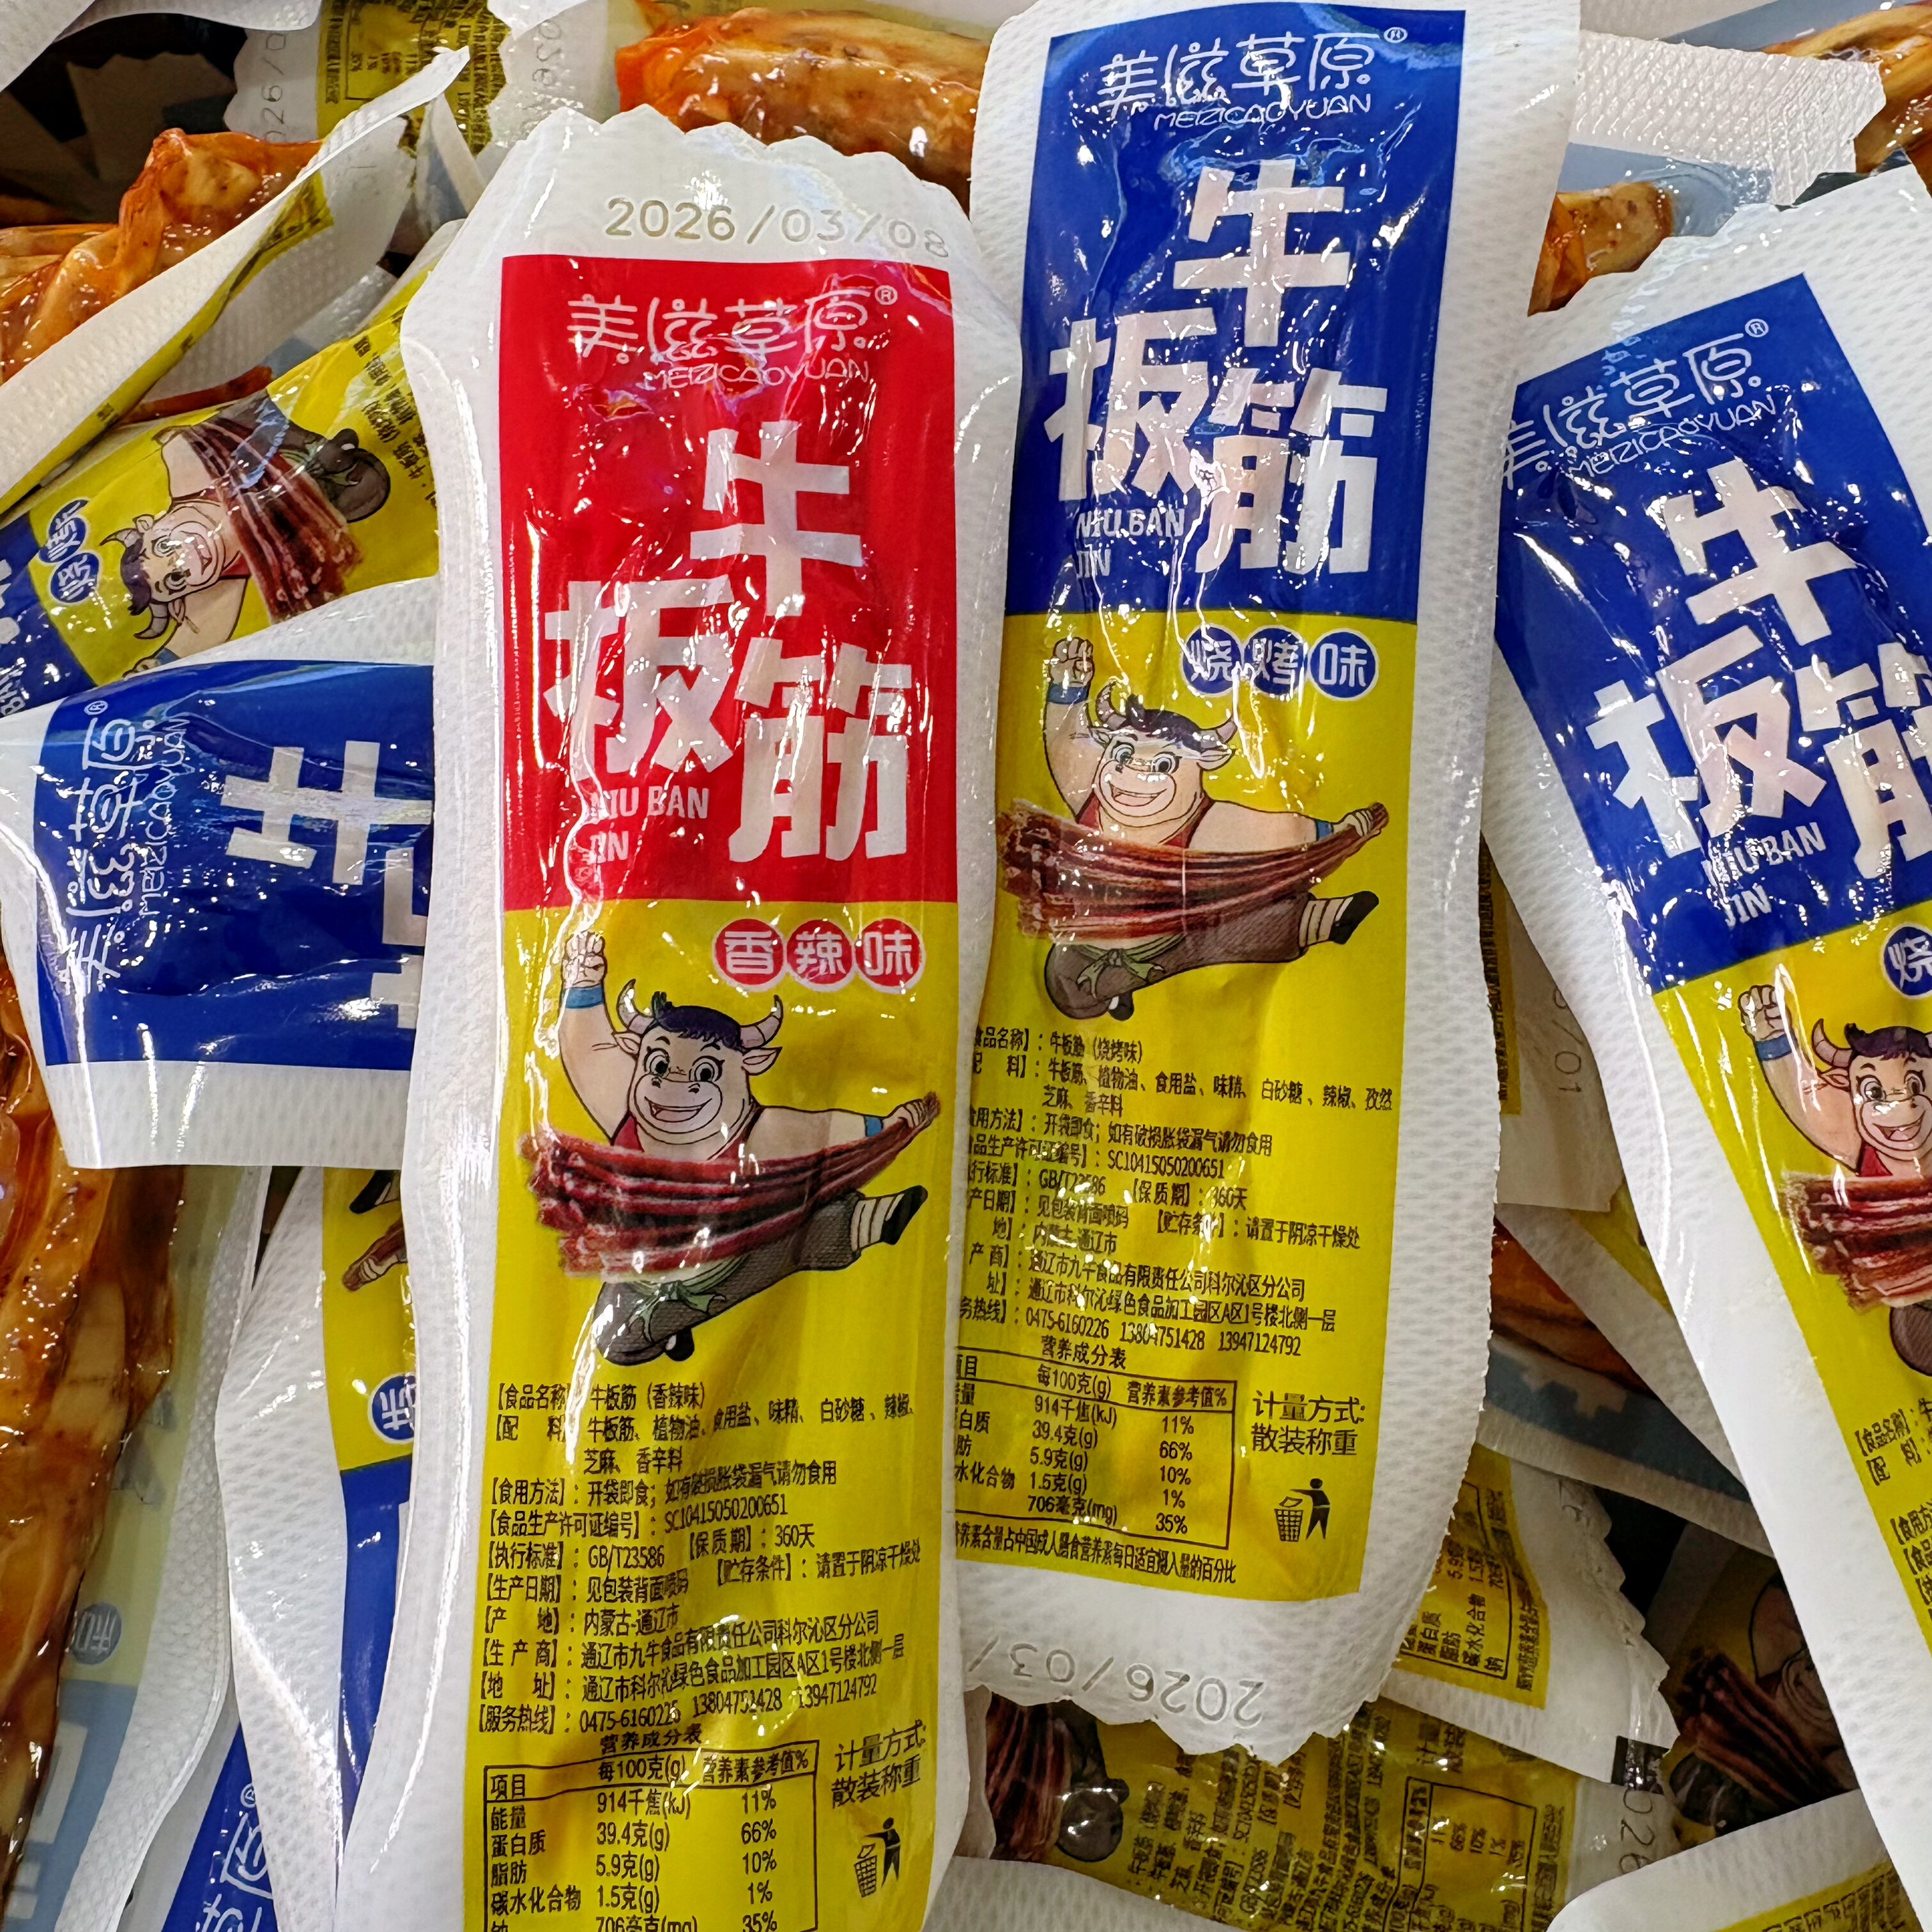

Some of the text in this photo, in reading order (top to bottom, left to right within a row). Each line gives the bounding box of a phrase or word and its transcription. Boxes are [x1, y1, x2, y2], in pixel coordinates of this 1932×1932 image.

[604, 197, 950, 258] 2026/03/08
[48, 502, 95, 602] 烧烤
[1188, 640, 1367, 688] 烧烤味
[648, 785, 709, 819] BAN
[1761, 821, 1828, 866] BAN
[724, 930, 914, 977] 香辣味
[1041, 1334, 1127, 1370] 营养成分表
[1218, 1330, 1301, 1356] 13947124792
[1032, 1419, 1099, 1450] 39.4克(g)
[1159, 1440, 1193, 1462] 66%
[1160, 1415, 1195, 1436] 11%
[1250, 1422, 1358, 1456] 散装称重
[1029, 1446, 1089, 1473] 5.9克(g)
[1159, 1465, 1192, 1486] 10%
[1030, 1471, 1088, 1497] 1.5克(g)
[1162, 1488, 1186, 1509] 1%
[1155, 1512, 1188, 1535] 35%
[599, 1723, 703, 1756] 营养成分表
[490, 1773, 526, 1800] 项目
[831, 1753, 921, 1809] 散装称重
[490, 1804, 527, 1831] 能量
[742, 1788, 777, 1814] 11%
[490, 1818, 777, 1859] 蛋白质 39.4克(g) 66%
[490, 1848, 778, 1887] 脂肪 5.9克(g) 10%
[490, 1879, 773, 1916] 碳水化合物 1.5克(g) 1%
[742, 1910, 778, 1932] 35%
